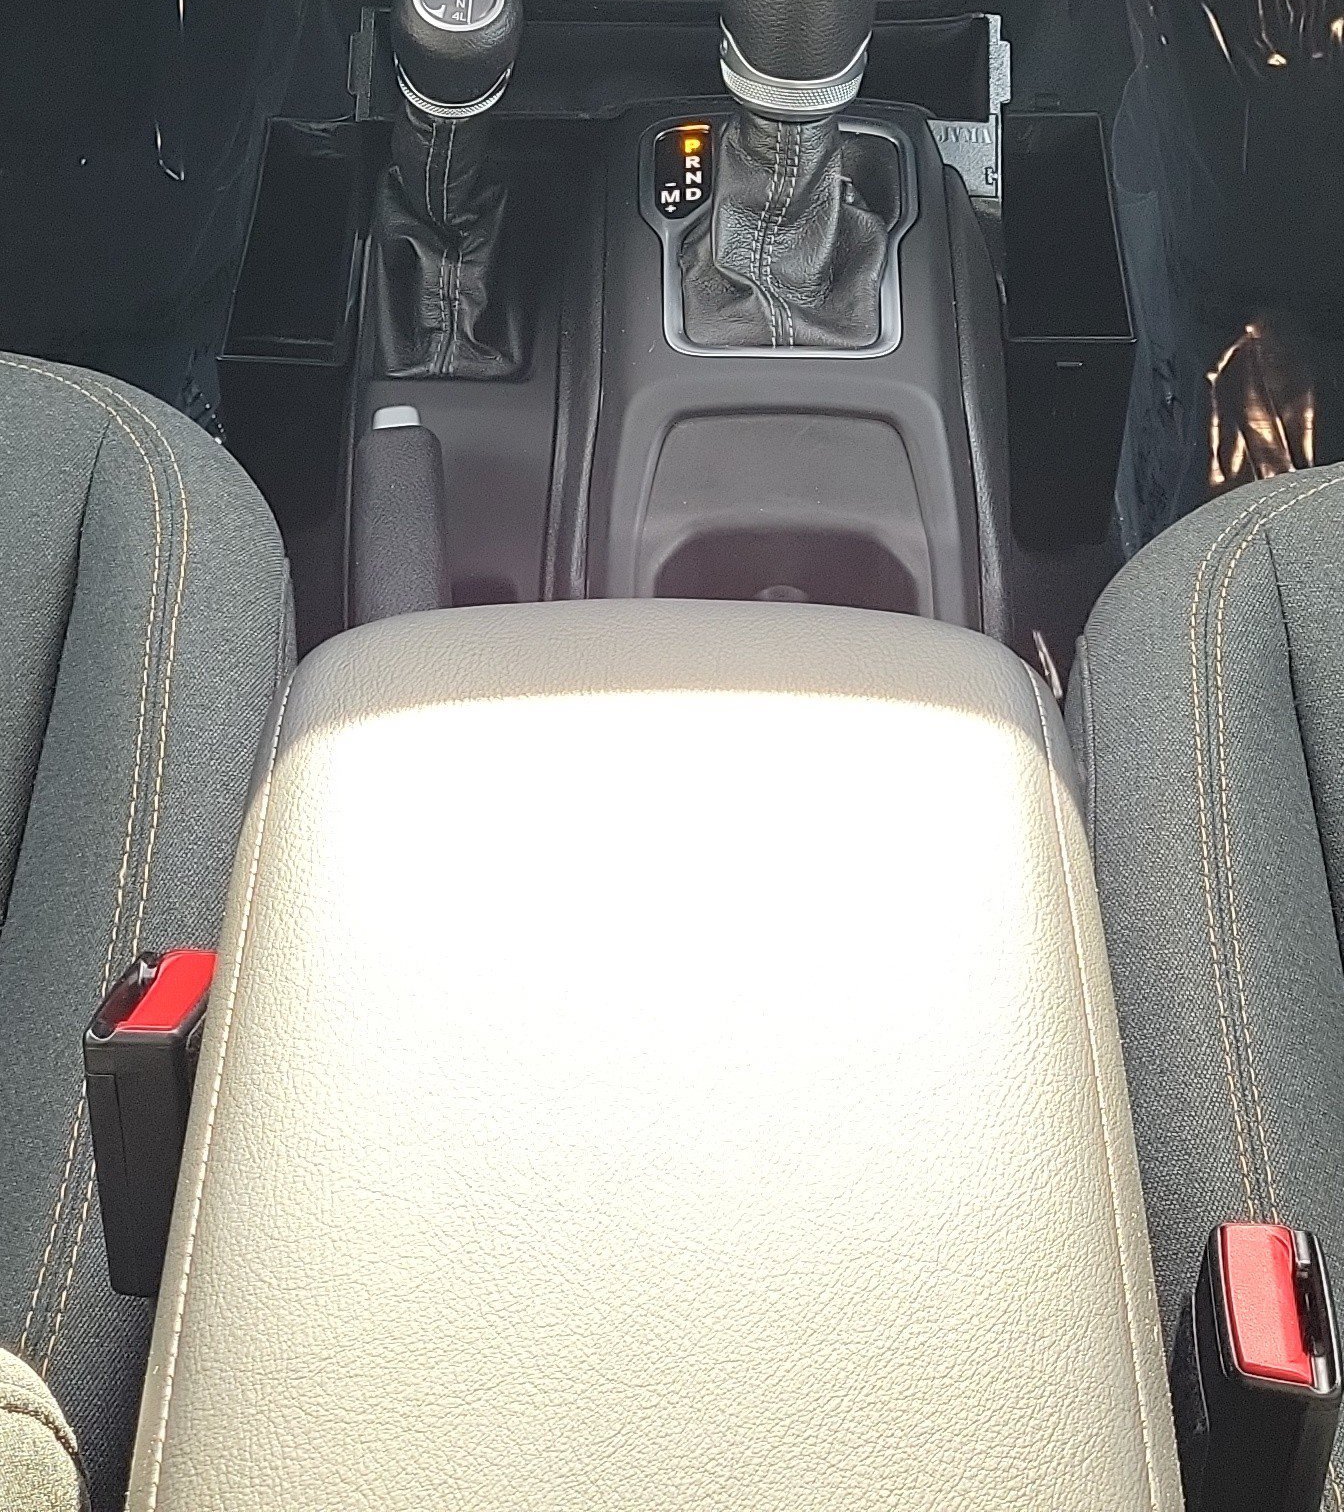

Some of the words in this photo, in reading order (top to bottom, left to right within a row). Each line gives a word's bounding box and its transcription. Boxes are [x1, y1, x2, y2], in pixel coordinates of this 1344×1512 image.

[456, 0, 465, 8] N
[452, 12, 466, 22] 4L
[684, 139, 700, 153] P
[685, 156, 700, 168] R
[685, 171, 702, 184] N
[661, 190, 680, 203] M
[685, 189, 702, 201] D
